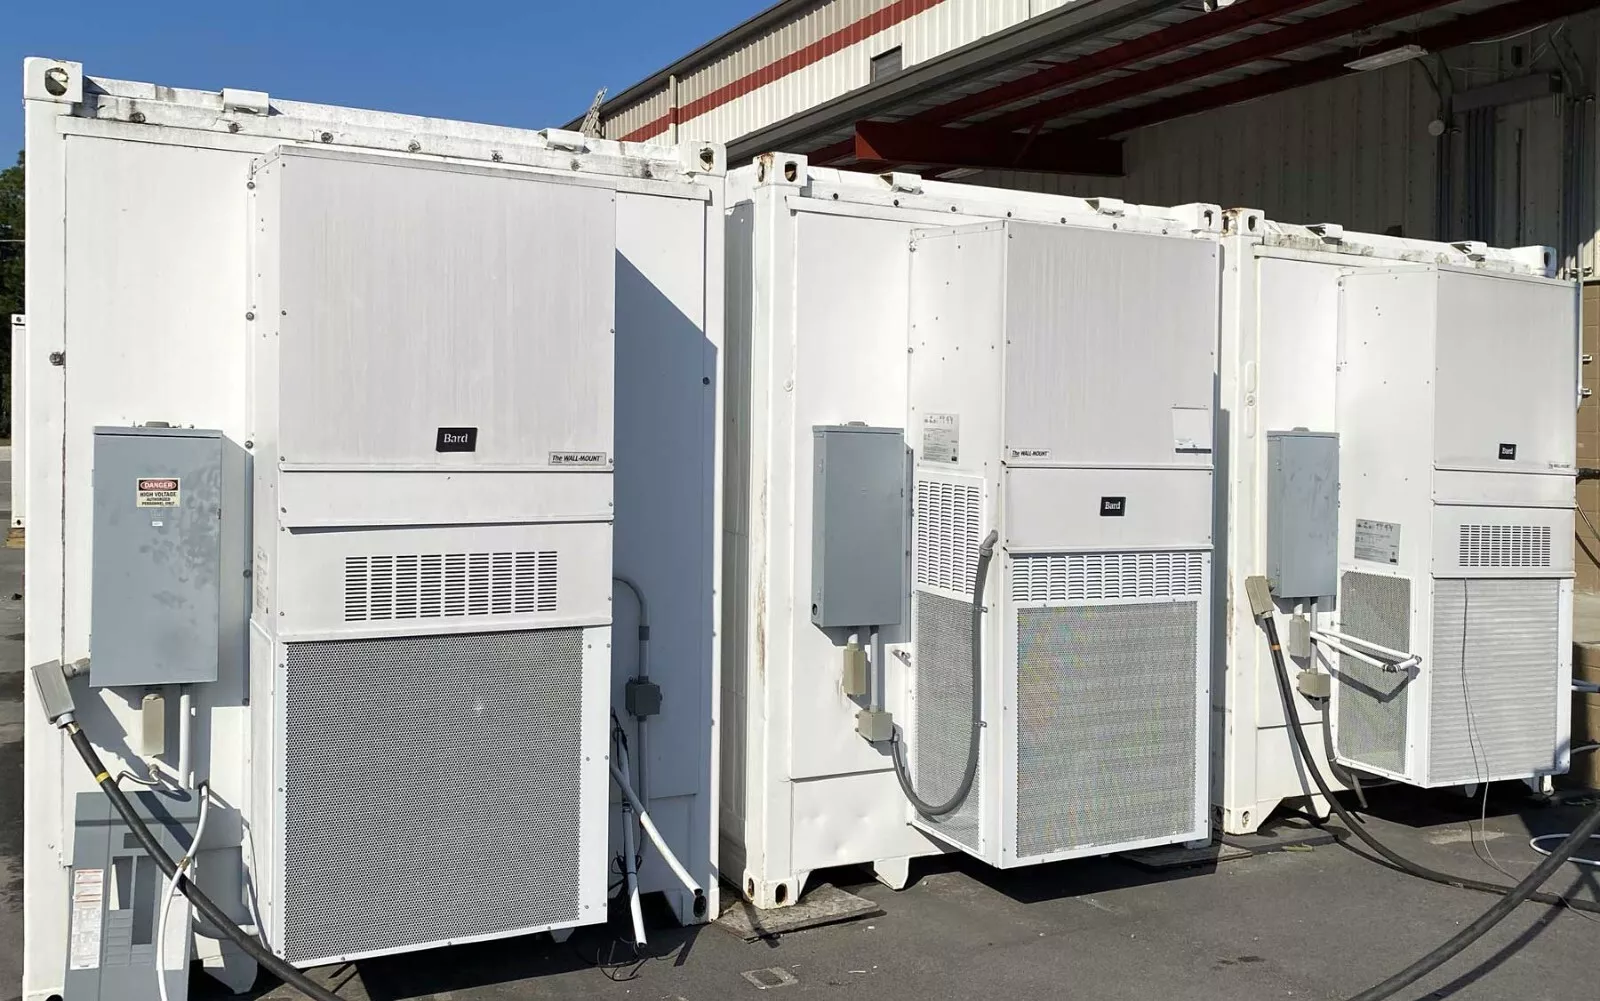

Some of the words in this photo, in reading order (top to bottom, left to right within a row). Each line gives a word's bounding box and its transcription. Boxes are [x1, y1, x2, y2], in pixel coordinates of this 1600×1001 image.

[443, 433, 468, 443] Bard
[552, 455, 562, 463] The
[1105, 501, 1120, 509] Bard
